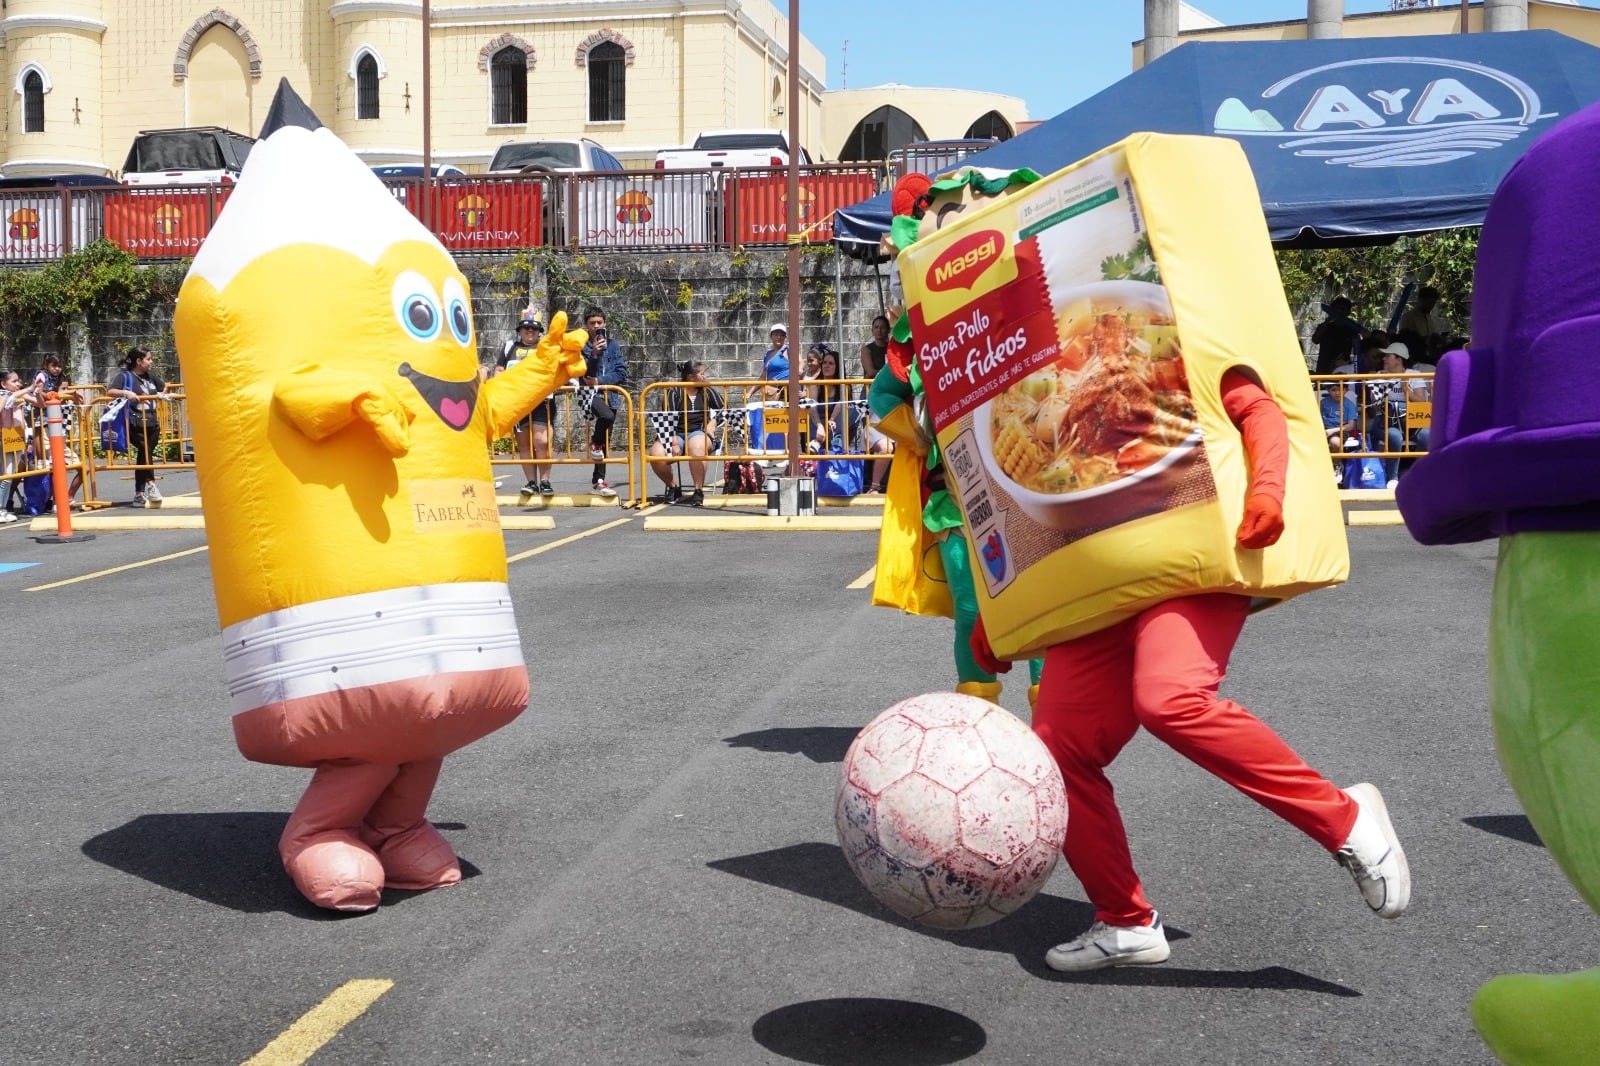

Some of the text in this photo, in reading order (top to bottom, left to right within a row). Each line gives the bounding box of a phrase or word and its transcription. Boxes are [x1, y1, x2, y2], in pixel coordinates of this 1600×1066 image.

[435, 230, 520, 241] AVIVIENDA
[934, 236, 996, 285] Maggi
[920, 308, 989, 371] Sopa Pollo
[938, 328, 1027, 391] con fideos
[949, 402, 960, 415] LOS
[960, 379, 999, 408] INGREDIENTES
[998, 370, 1010, 384] QUE
[1010, 362, 1023, 376] MÁS
[1023, 356, 1031, 367] TE
[968, 499, 993, 531] HIERRO
